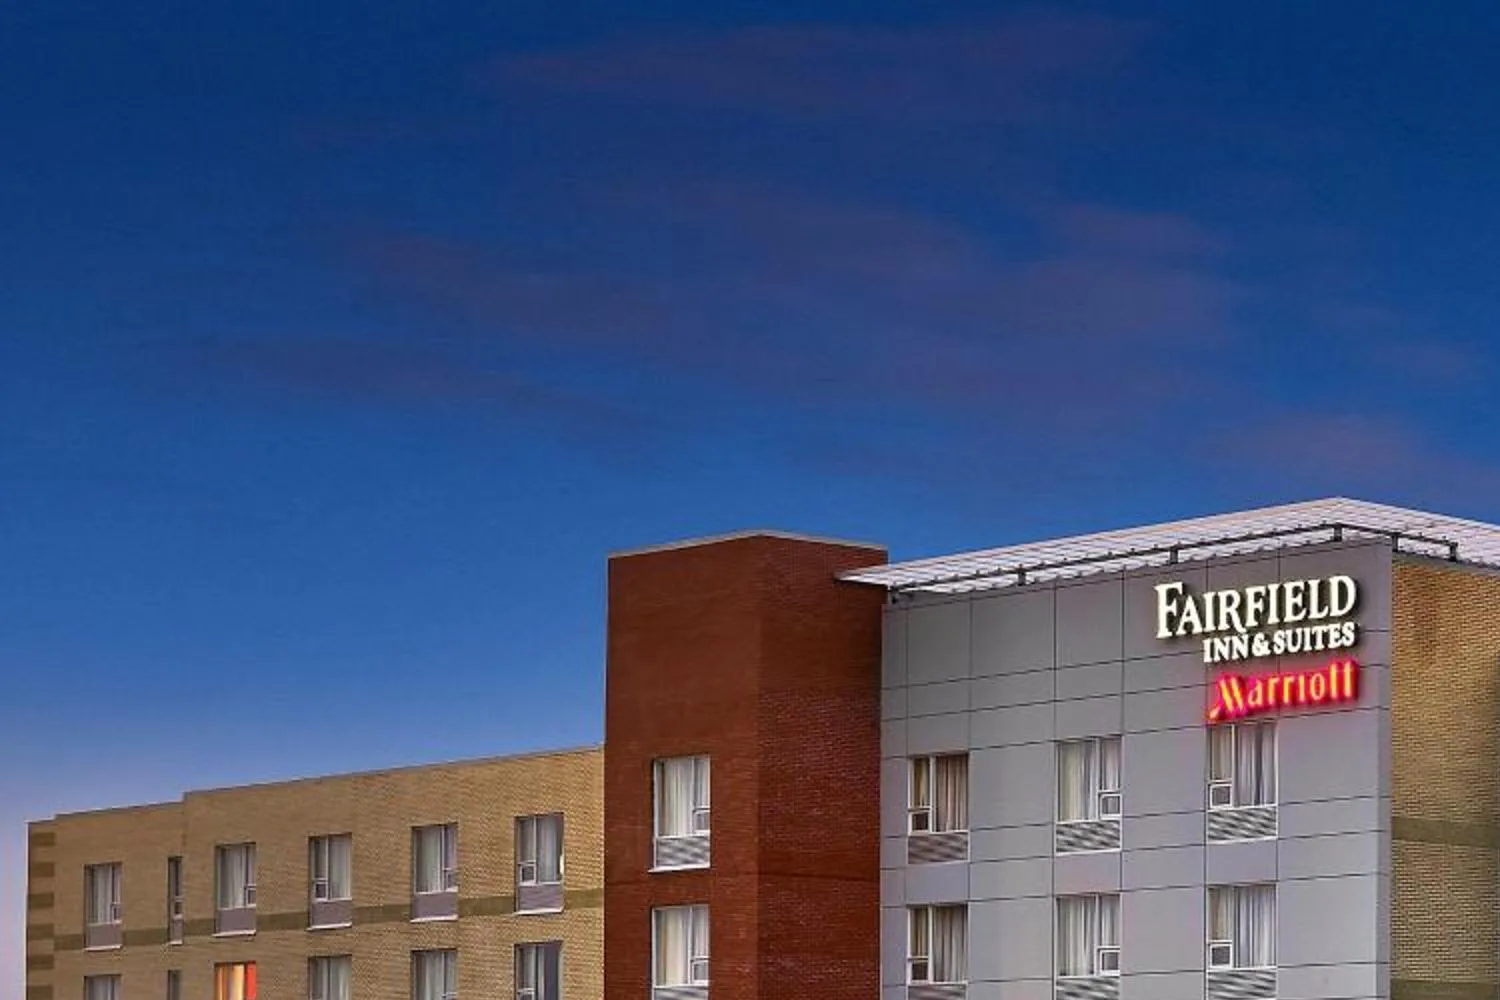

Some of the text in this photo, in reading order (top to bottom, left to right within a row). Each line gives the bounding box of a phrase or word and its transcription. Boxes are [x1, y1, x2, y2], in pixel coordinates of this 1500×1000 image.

[1154, 575, 1358, 640] FAIRFIELD
[1202, 634, 1249, 663] INN
[1273, 621, 1356, 655] SUITES
[1207, 658, 1358, 723] Marriott
